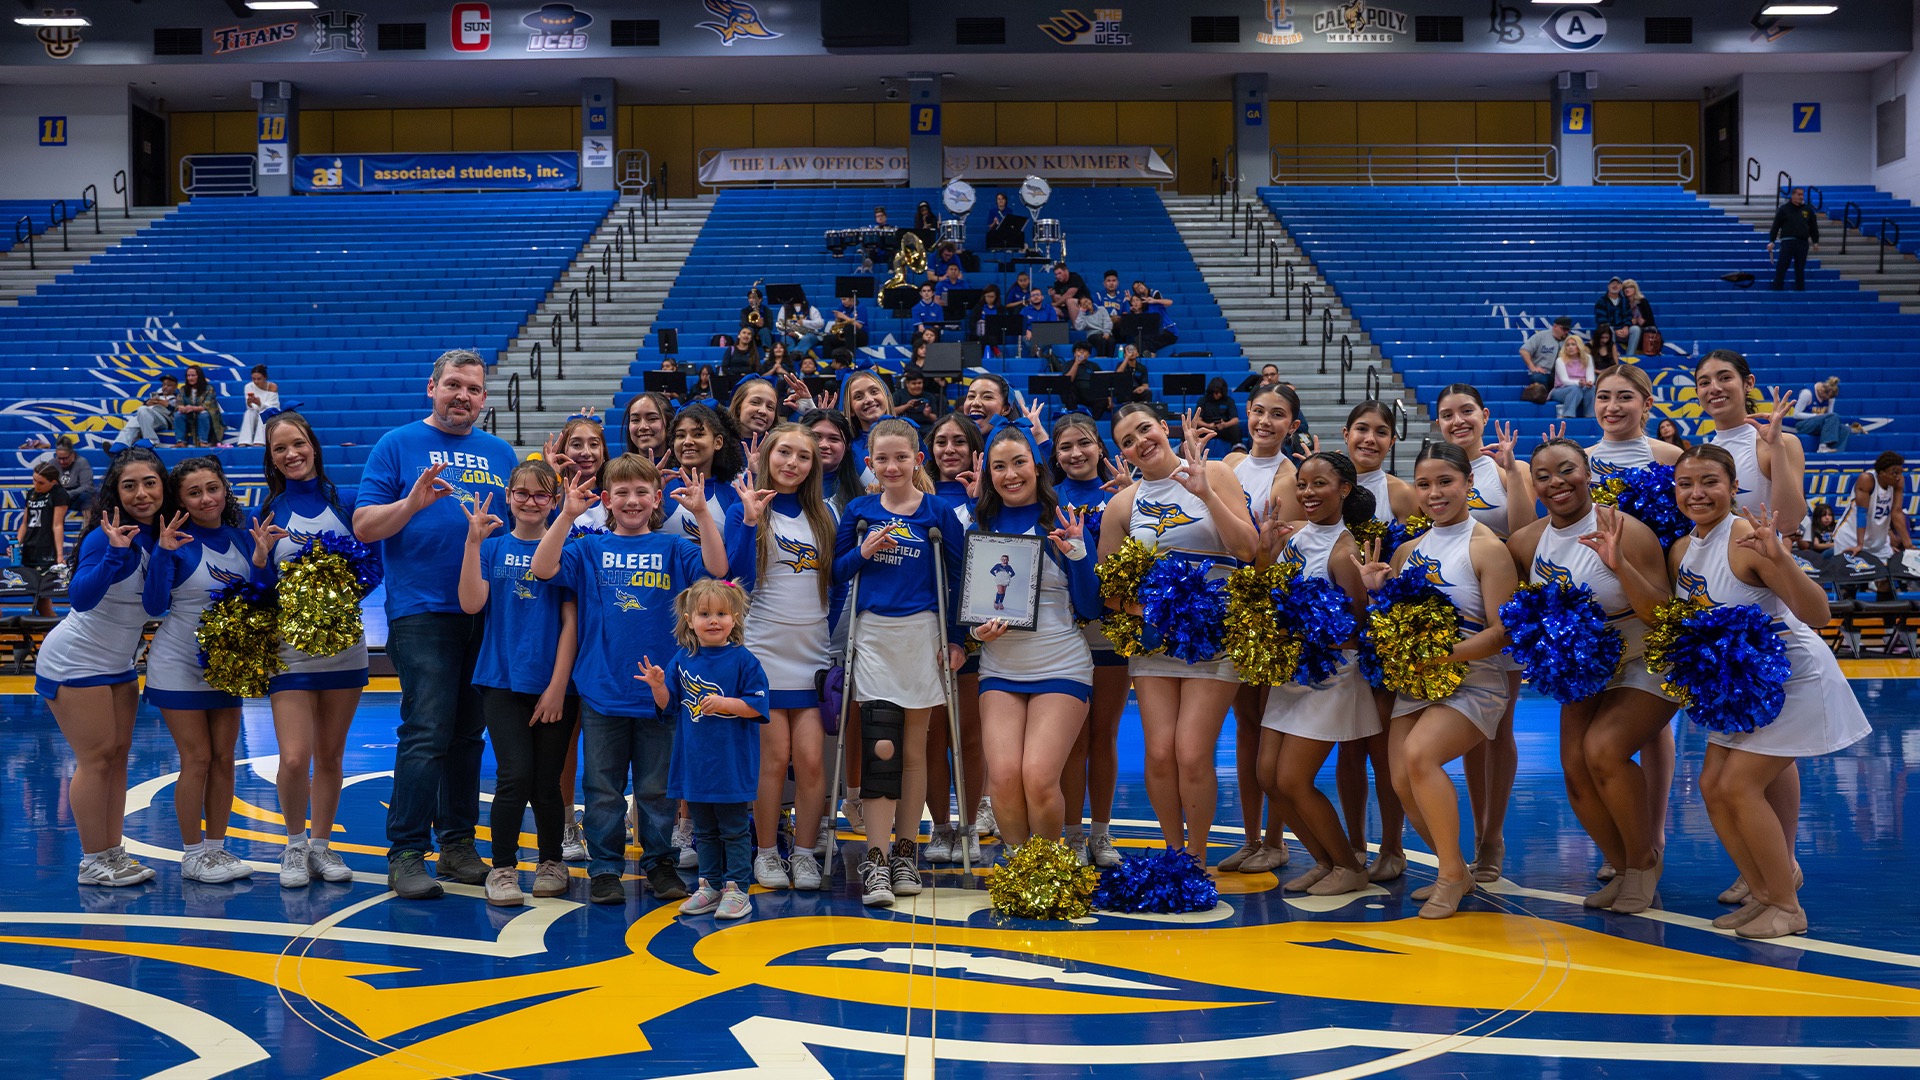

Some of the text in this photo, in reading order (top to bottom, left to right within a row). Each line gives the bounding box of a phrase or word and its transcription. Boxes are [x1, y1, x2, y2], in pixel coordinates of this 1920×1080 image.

[1094, 9, 1122, 21] THE
[1314, 8, 1407, 33] CAL POLY
[311, 11, 366, 54] H
[464, 22, 490, 32] SUN
[1095, 21, 1119, 32] BIG
[215, 23, 296, 50] TITANS
[529, 35, 587, 50] UCSB
[1095, 33, 1131, 44] WEST
[1256, 32, 1303, 45] RIVERSIDE
[591, 115, 604, 123] GA
[918, 108, 933, 131] 9
[1569, 107, 1585, 130] 8
[1799, 106, 1815, 129] 7
[42, 120, 64, 142] 11
[261, 117, 285, 140] 10
[730, 158, 764, 171] THE
[769, 157, 808, 171] LAW
[812, 156, 884, 171] OFFICES
[975, 154, 1130, 170] DIXON KUMMER
[312, 158, 343, 186] asi
[374, 164, 565, 181] associated students, inc.
[429, 451, 489, 471] BLEED
[29, 510, 41, 528] 21
[504, 553, 533, 567] BLE
[602, 552, 662, 570] BLEED
[874, 553, 904, 566] SPIRIT
